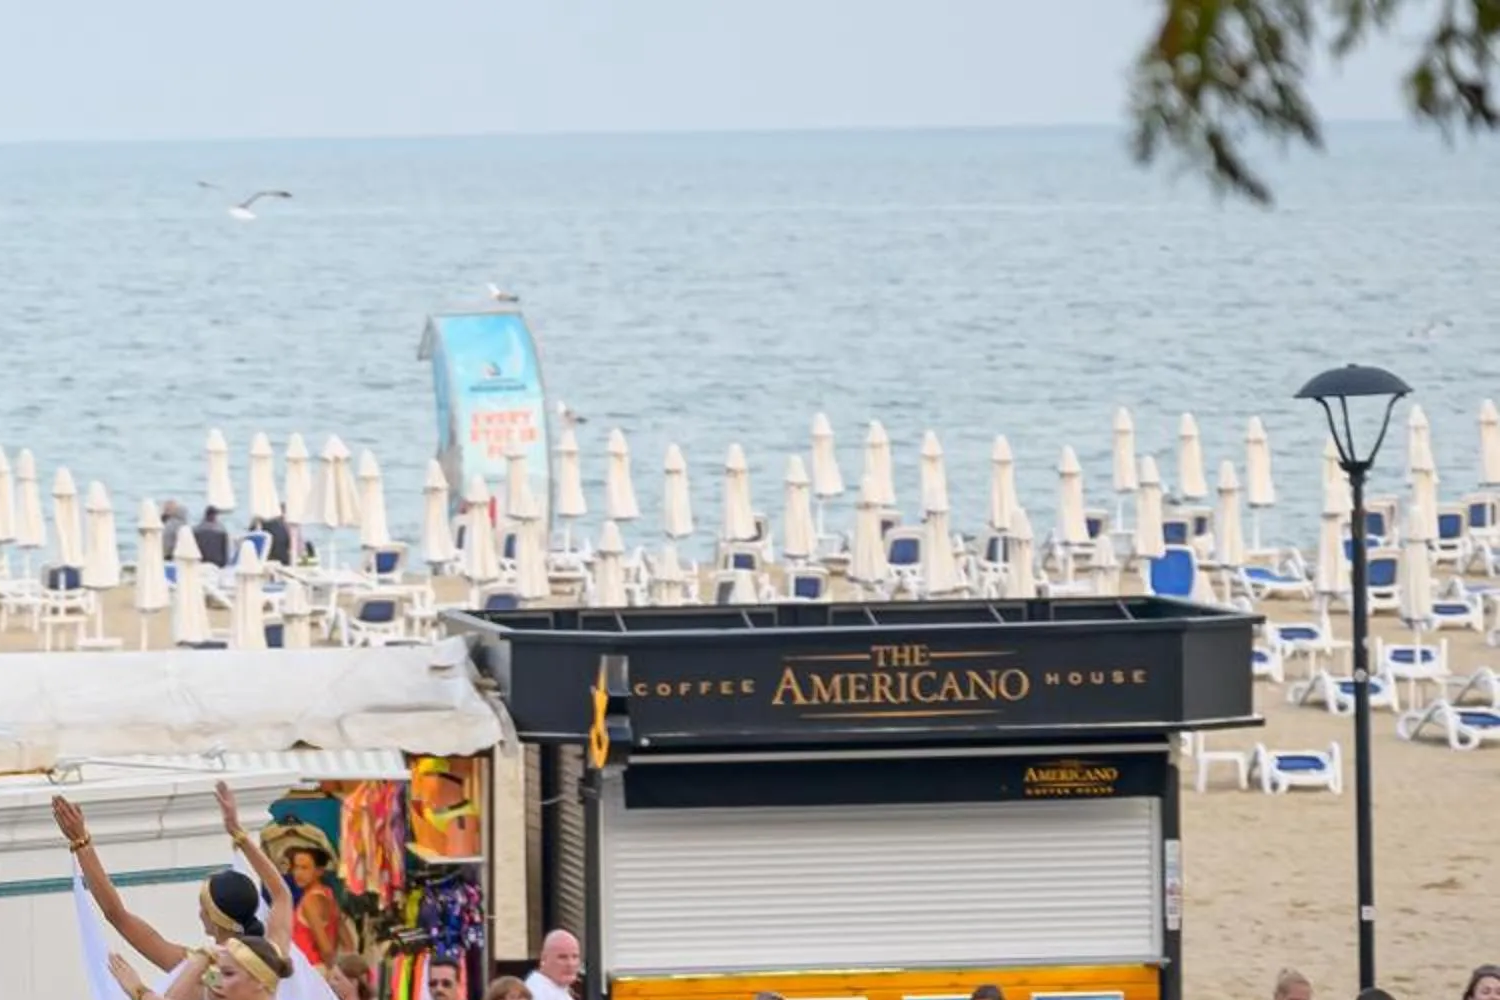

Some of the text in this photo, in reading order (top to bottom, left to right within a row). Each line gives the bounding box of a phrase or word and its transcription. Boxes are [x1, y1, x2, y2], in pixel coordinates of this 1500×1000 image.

[871, 644, 930, 668] THE
[633, 678, 756, 697] COFFEE
[771, 666, 1031, 705] AMERICANO
[1045, 669, 1148, 686] HOUSE
